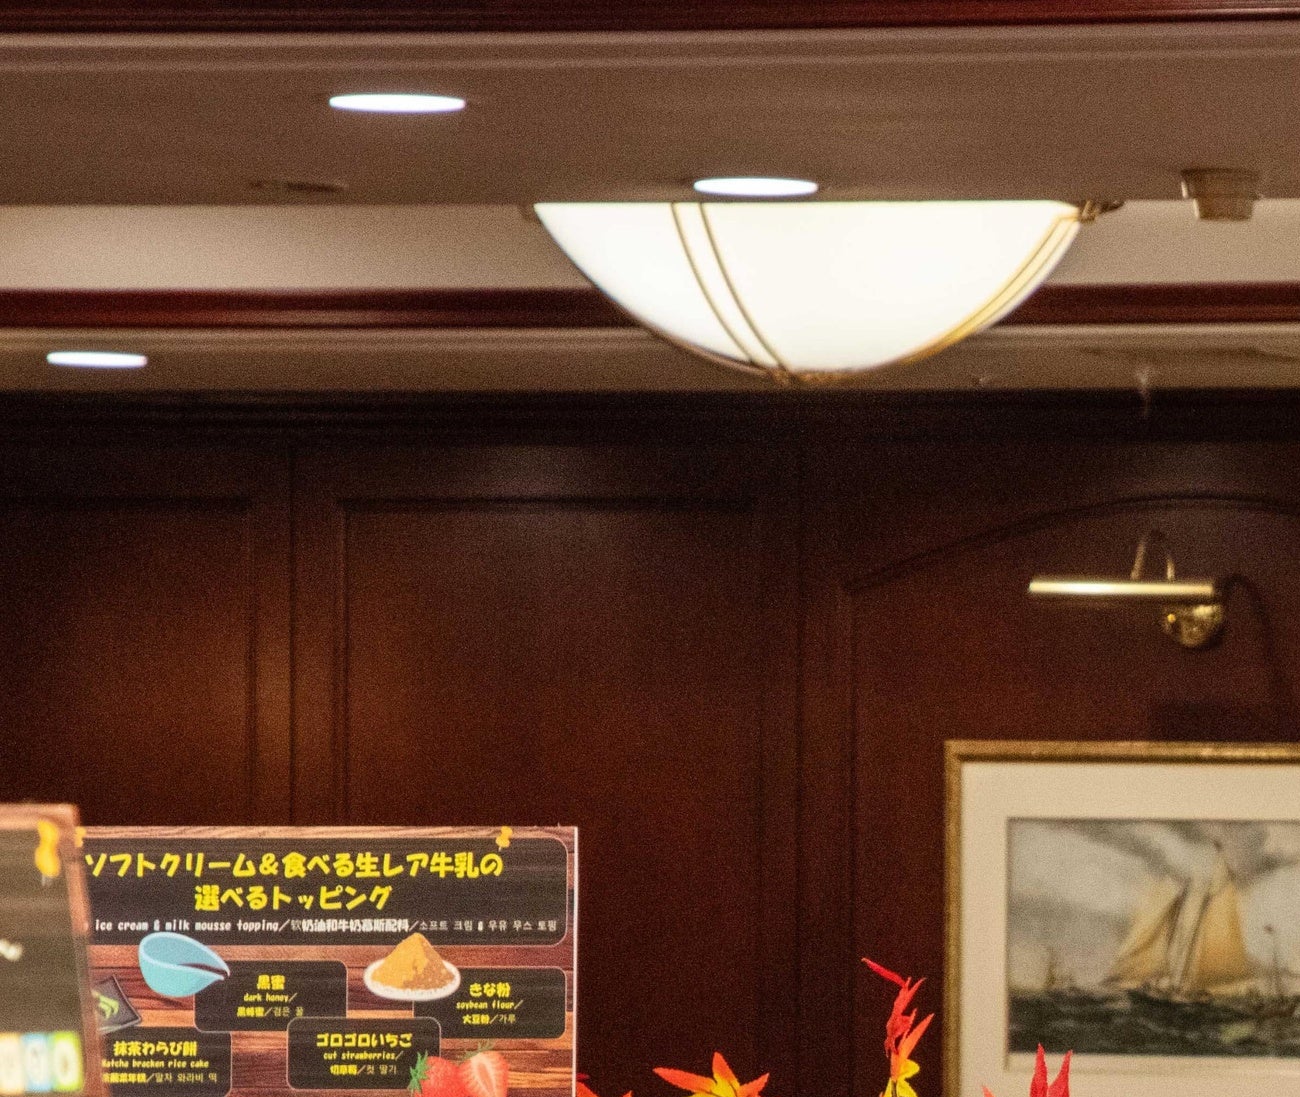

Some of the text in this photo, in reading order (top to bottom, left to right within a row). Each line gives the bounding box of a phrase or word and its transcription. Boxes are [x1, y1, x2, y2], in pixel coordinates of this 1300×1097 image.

[195, 885, 392, 911] 選べるトッピング
[469, 982, 511, 998] きな粉
[316, 1033, 413, 1048] ゴロゴロいちご
